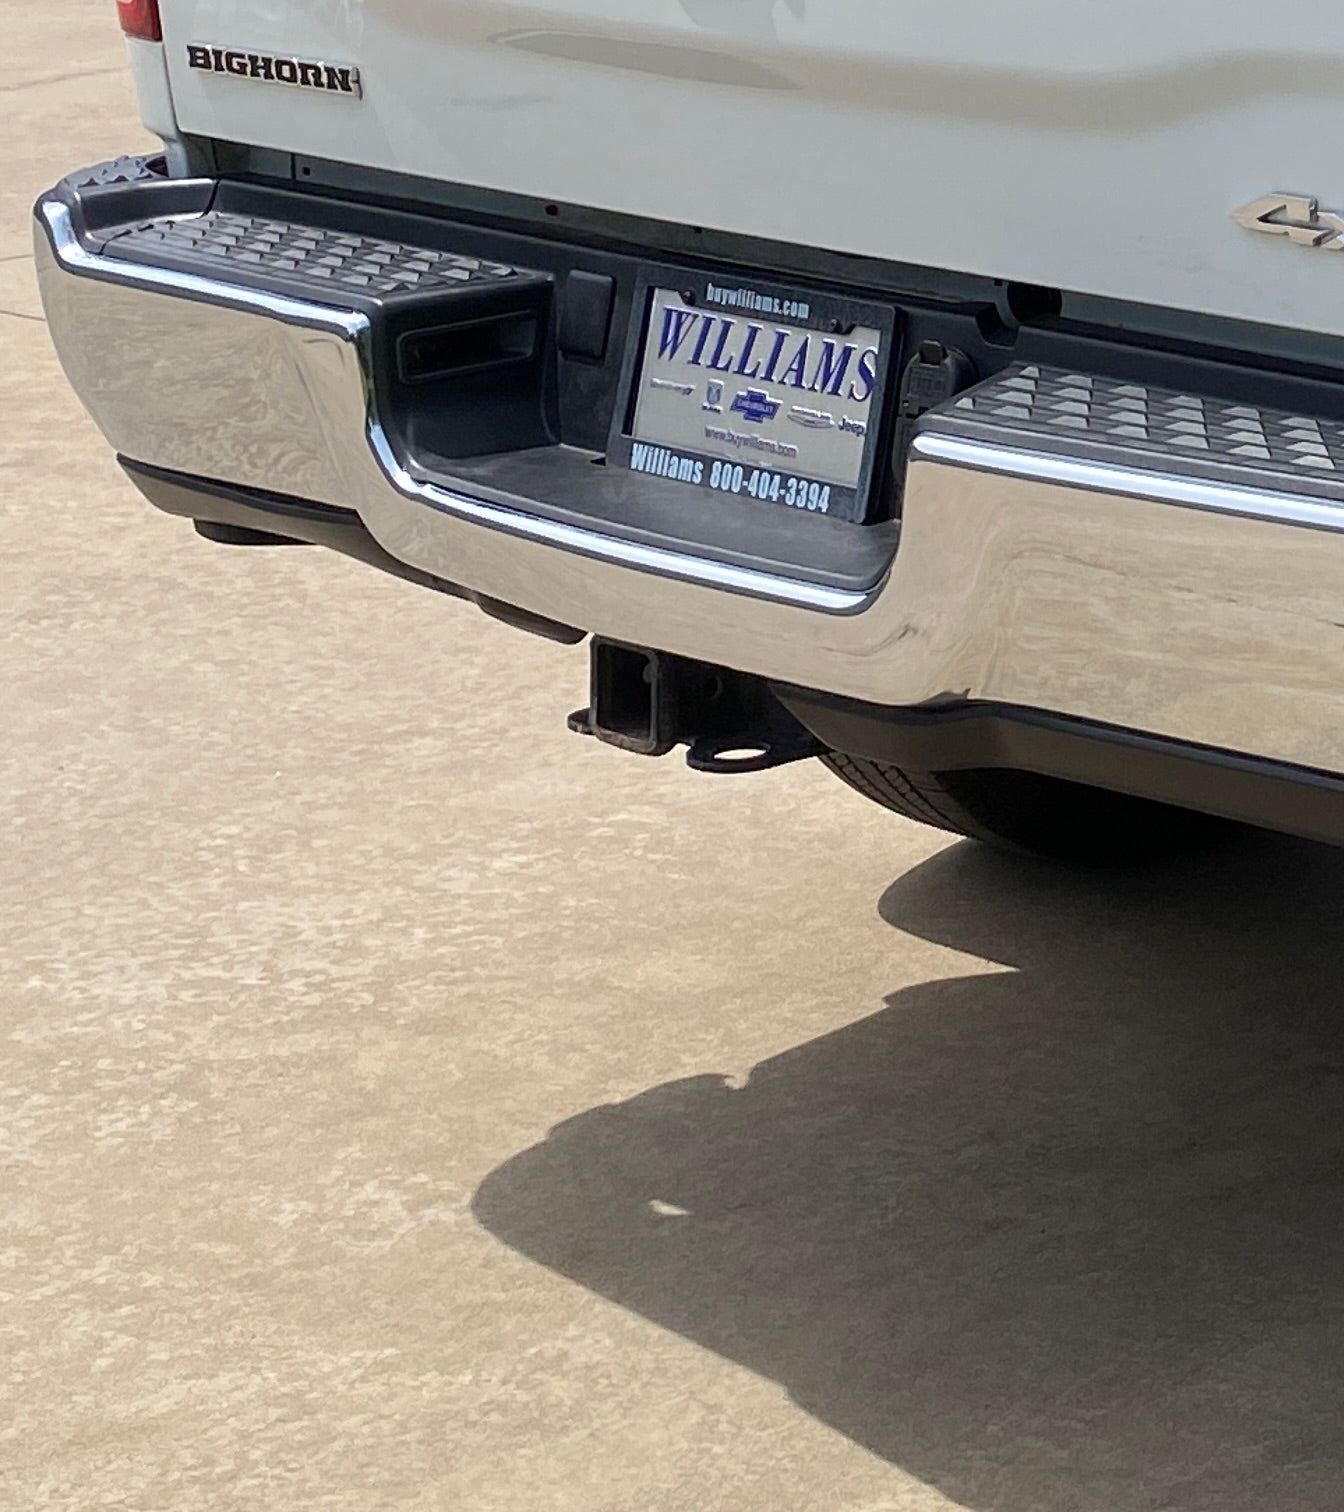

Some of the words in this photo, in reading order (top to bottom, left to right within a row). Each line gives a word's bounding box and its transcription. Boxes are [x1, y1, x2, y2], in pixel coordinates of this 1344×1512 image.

[187, 43, 354, 93] BIGHORN
[706, 283, 809, 319] buywilliams.com
[657, 306, 878, 403] WILLIAMS
[630, 443, 703, 484] Williams
[710, 460, 830, 513] 800-404-3394
